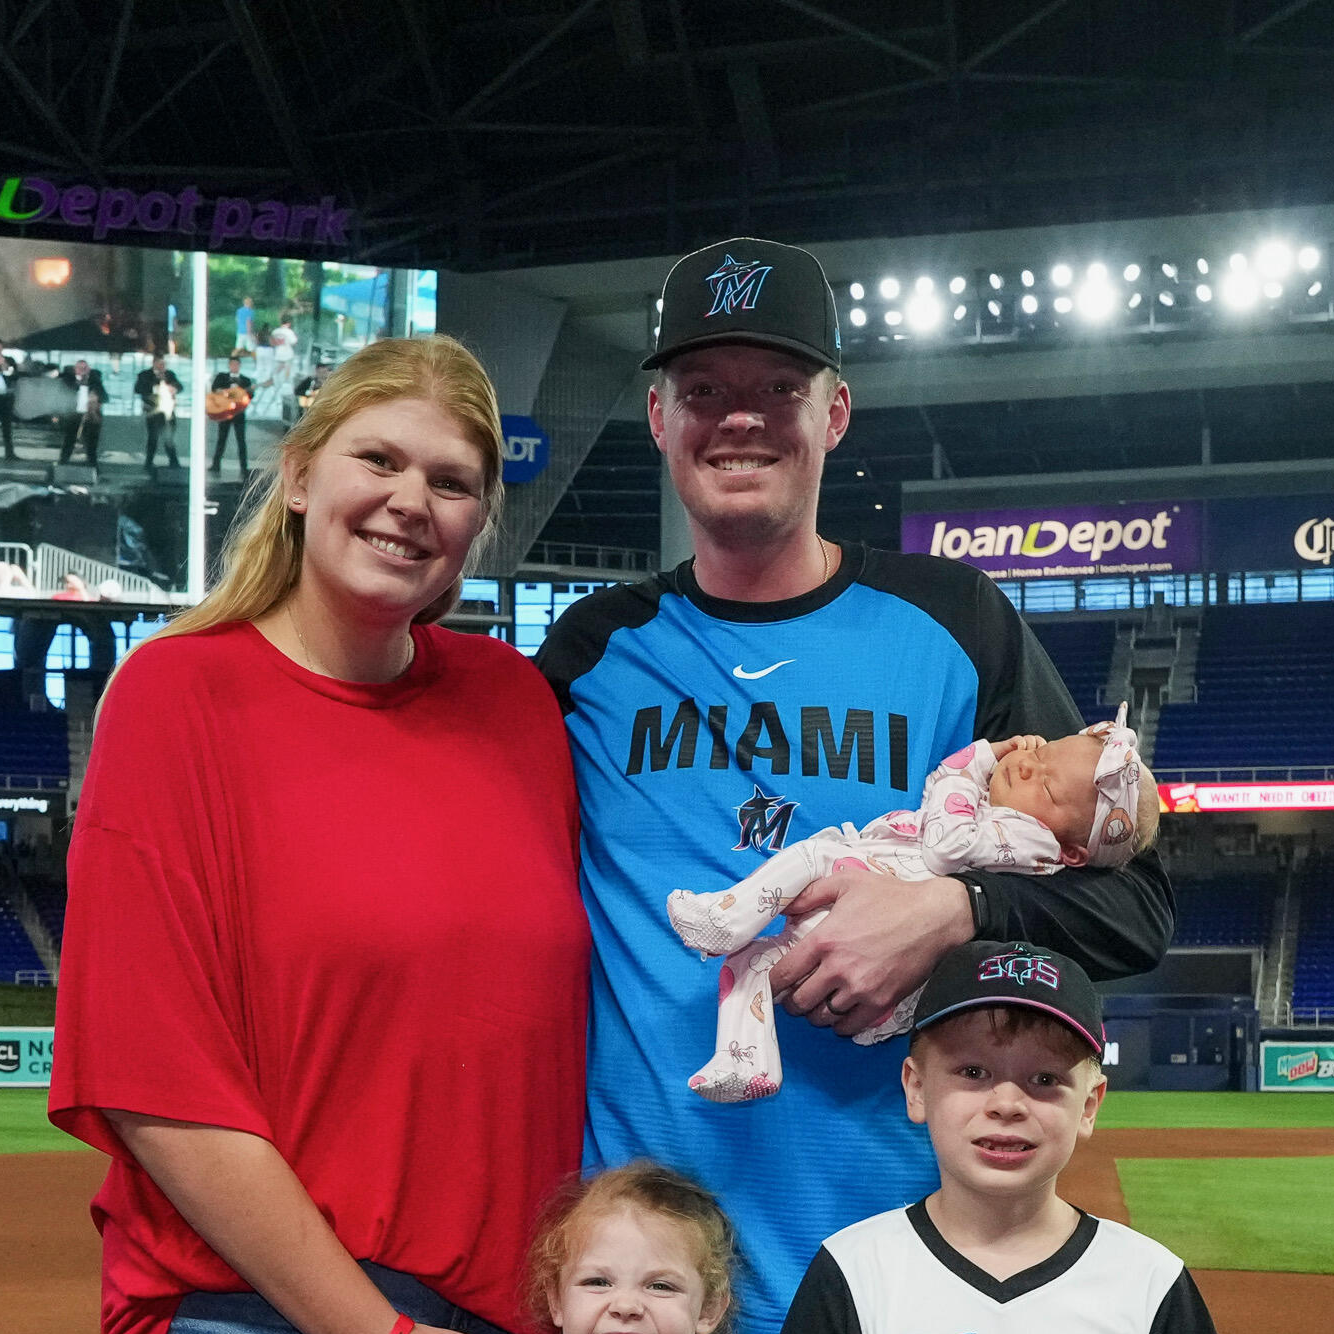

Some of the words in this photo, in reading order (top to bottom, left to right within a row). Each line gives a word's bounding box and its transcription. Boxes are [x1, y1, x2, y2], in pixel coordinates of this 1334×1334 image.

[208, 195, 354, 248] park
[930, 512, 1171, 560] loanDepot
[626, 697, 908, 792] MIAMI
